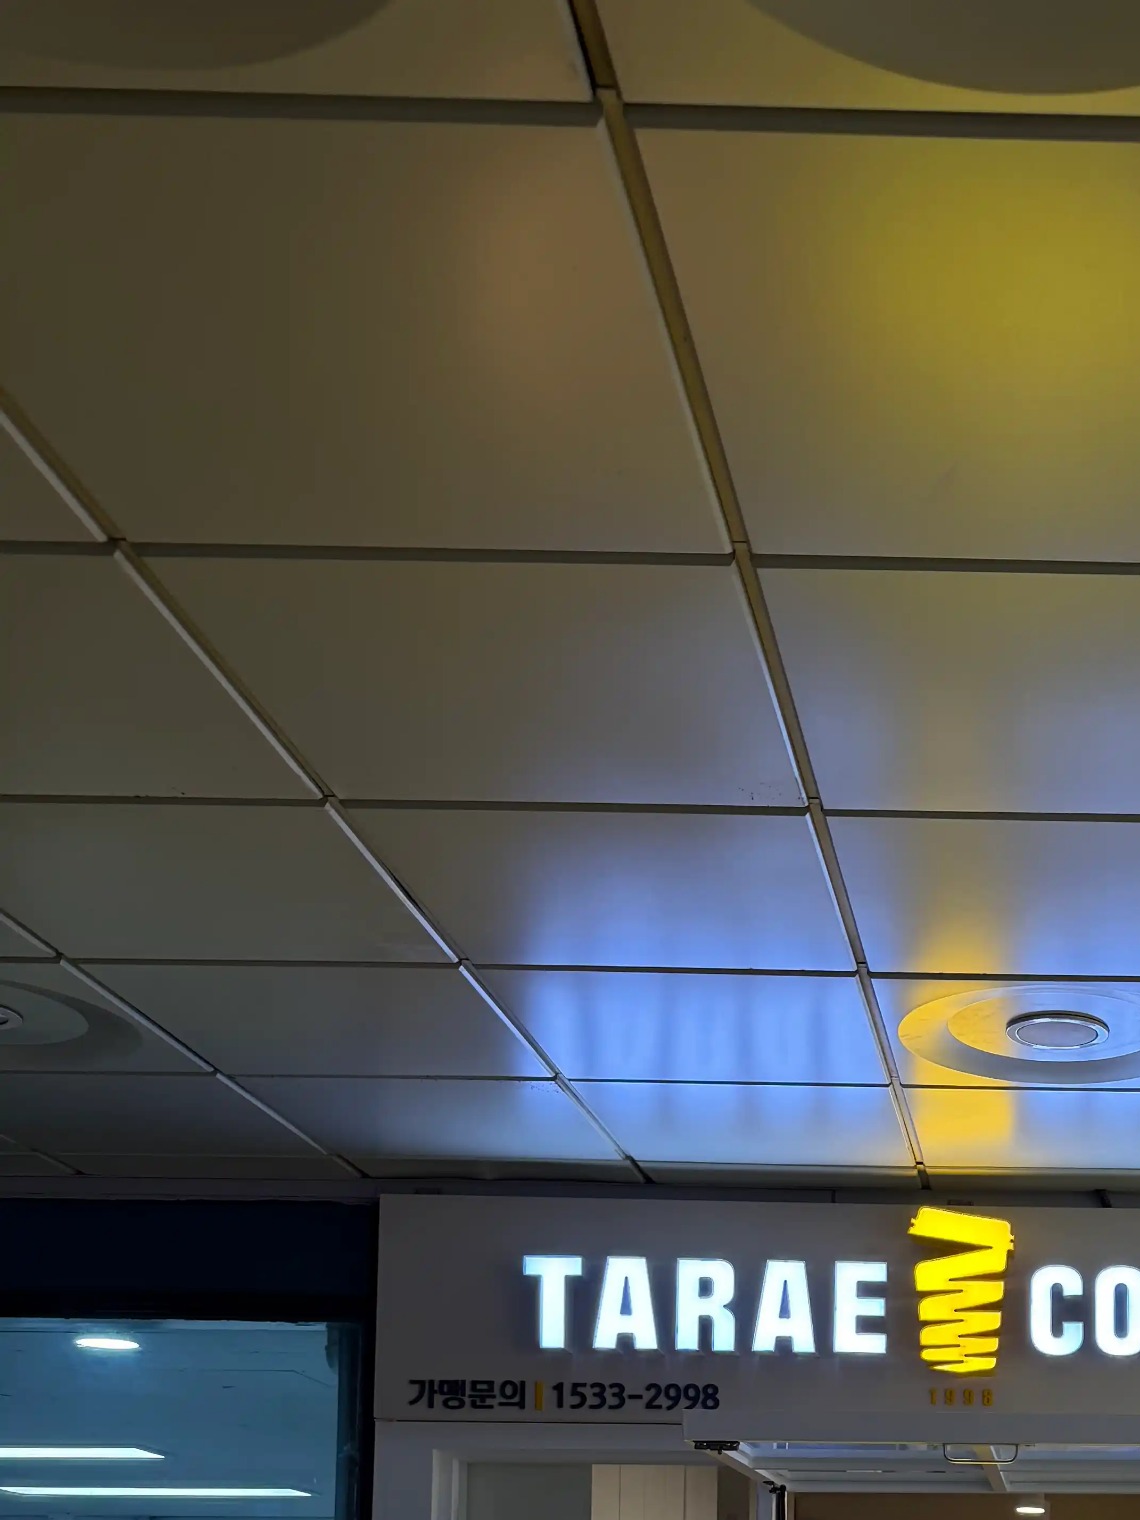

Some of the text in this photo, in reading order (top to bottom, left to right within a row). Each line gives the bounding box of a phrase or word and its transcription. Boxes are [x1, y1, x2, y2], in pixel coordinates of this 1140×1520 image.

[523, 1255, 887, 1354] TARAE
[408, 1379, 720, 1410] 가맹문의 1533-2998
[928, 1387, 994, 1406] 1998
